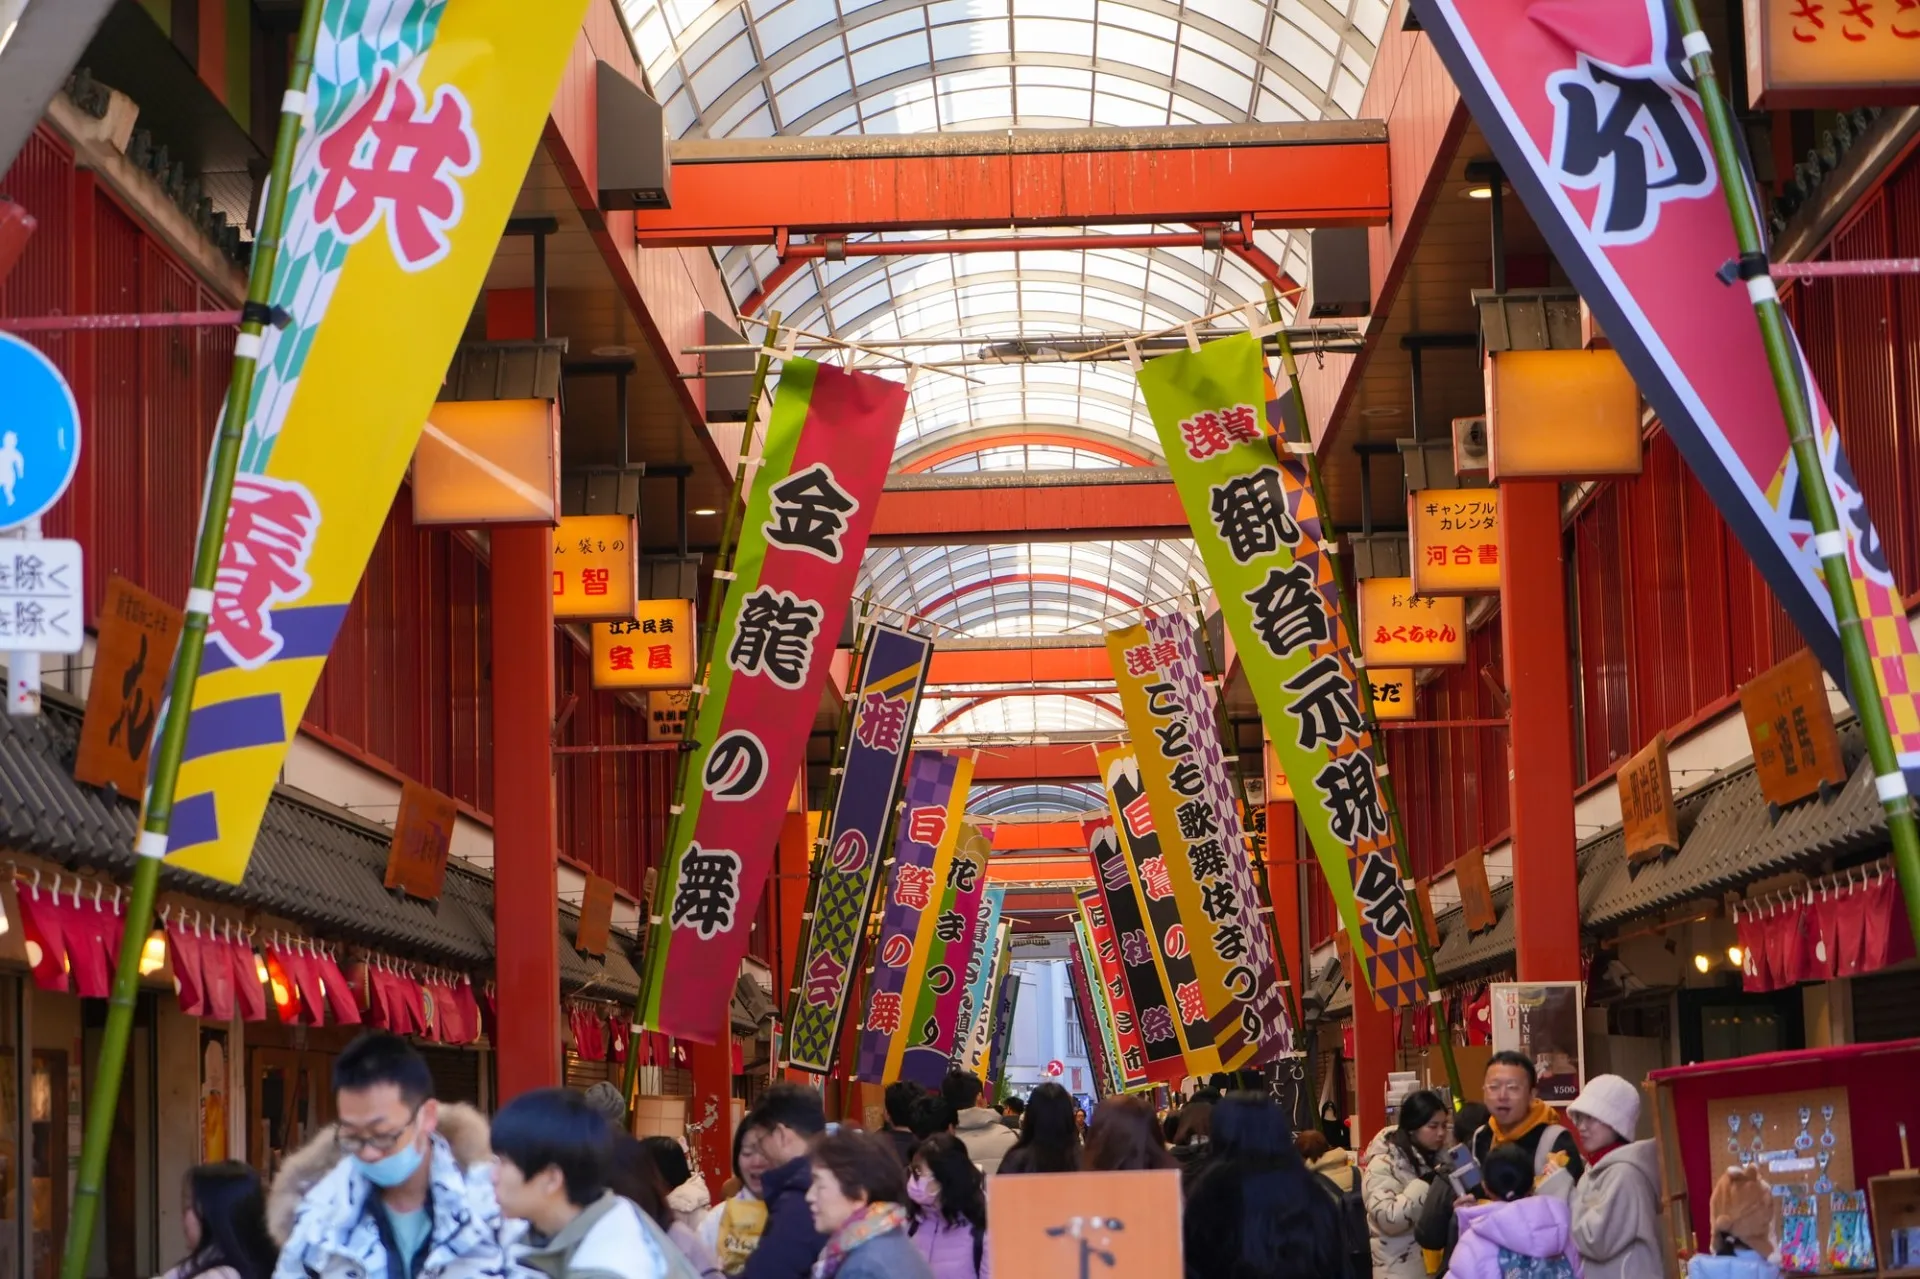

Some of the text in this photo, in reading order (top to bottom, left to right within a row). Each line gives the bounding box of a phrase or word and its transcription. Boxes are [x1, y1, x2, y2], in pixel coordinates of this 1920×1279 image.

[1181, 407, 1260, 458] 浅草
[1426, 503, 1498, 516] ギャンブル
[1440, 517, 1498, 530] カレンダ
[579, 538, 624, 554] 袋もの
[1427, 544, 1499, 566] 河合書
[1392, 594, 1436, 609] お食事
[609, 618, 674, 634] 江戸民芸
[1374, 624, 1456, 644] ふくちゃん
[609, 644, 672, 671] 宝屋
[1127, 640, 1180, 675] 浅草
[672, 467, 856, 934] 金龍の舞
[1212, 469, 1411, 938] 観音示現会
[807, 692, 906, 1009] 雅の会
[1146, 684, 1261, 1041] こども歌舞伎まつり
[920, 857, 978, 1046] 花まつり
[1103, 852, 1175, 1043] 三社祭
[1520, 1004, 1531, 1044] WINE
